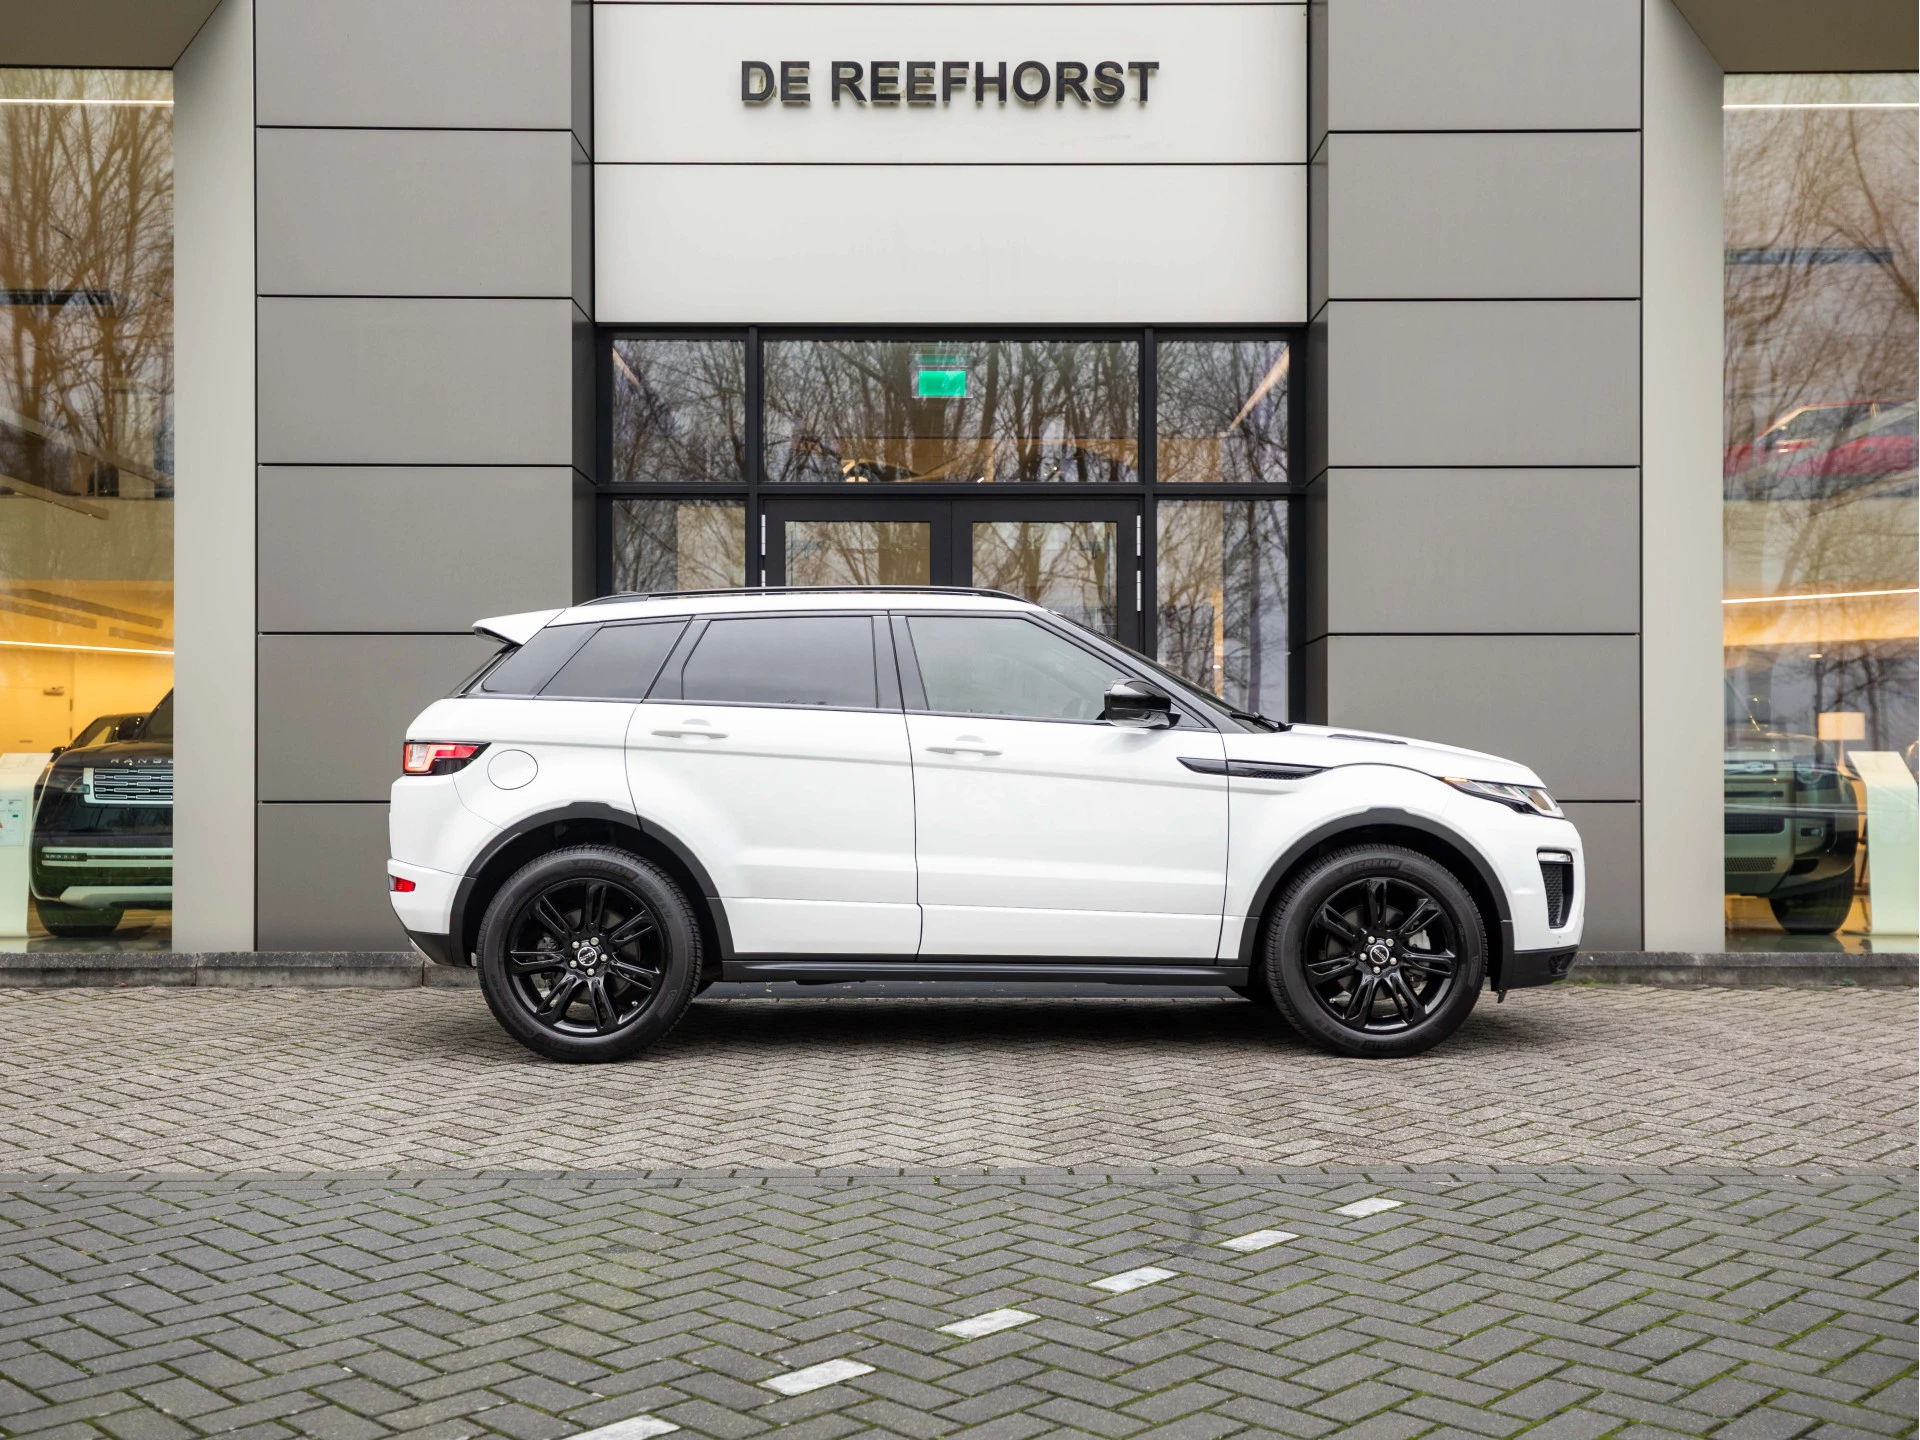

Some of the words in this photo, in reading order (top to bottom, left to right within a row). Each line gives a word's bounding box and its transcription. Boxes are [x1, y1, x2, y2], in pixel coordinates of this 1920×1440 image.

[741, 60, 811, 103] DE
[831, 60, 1160, 104] REEFHORST
[1342, 858, 1401, 874] MICHELIN
